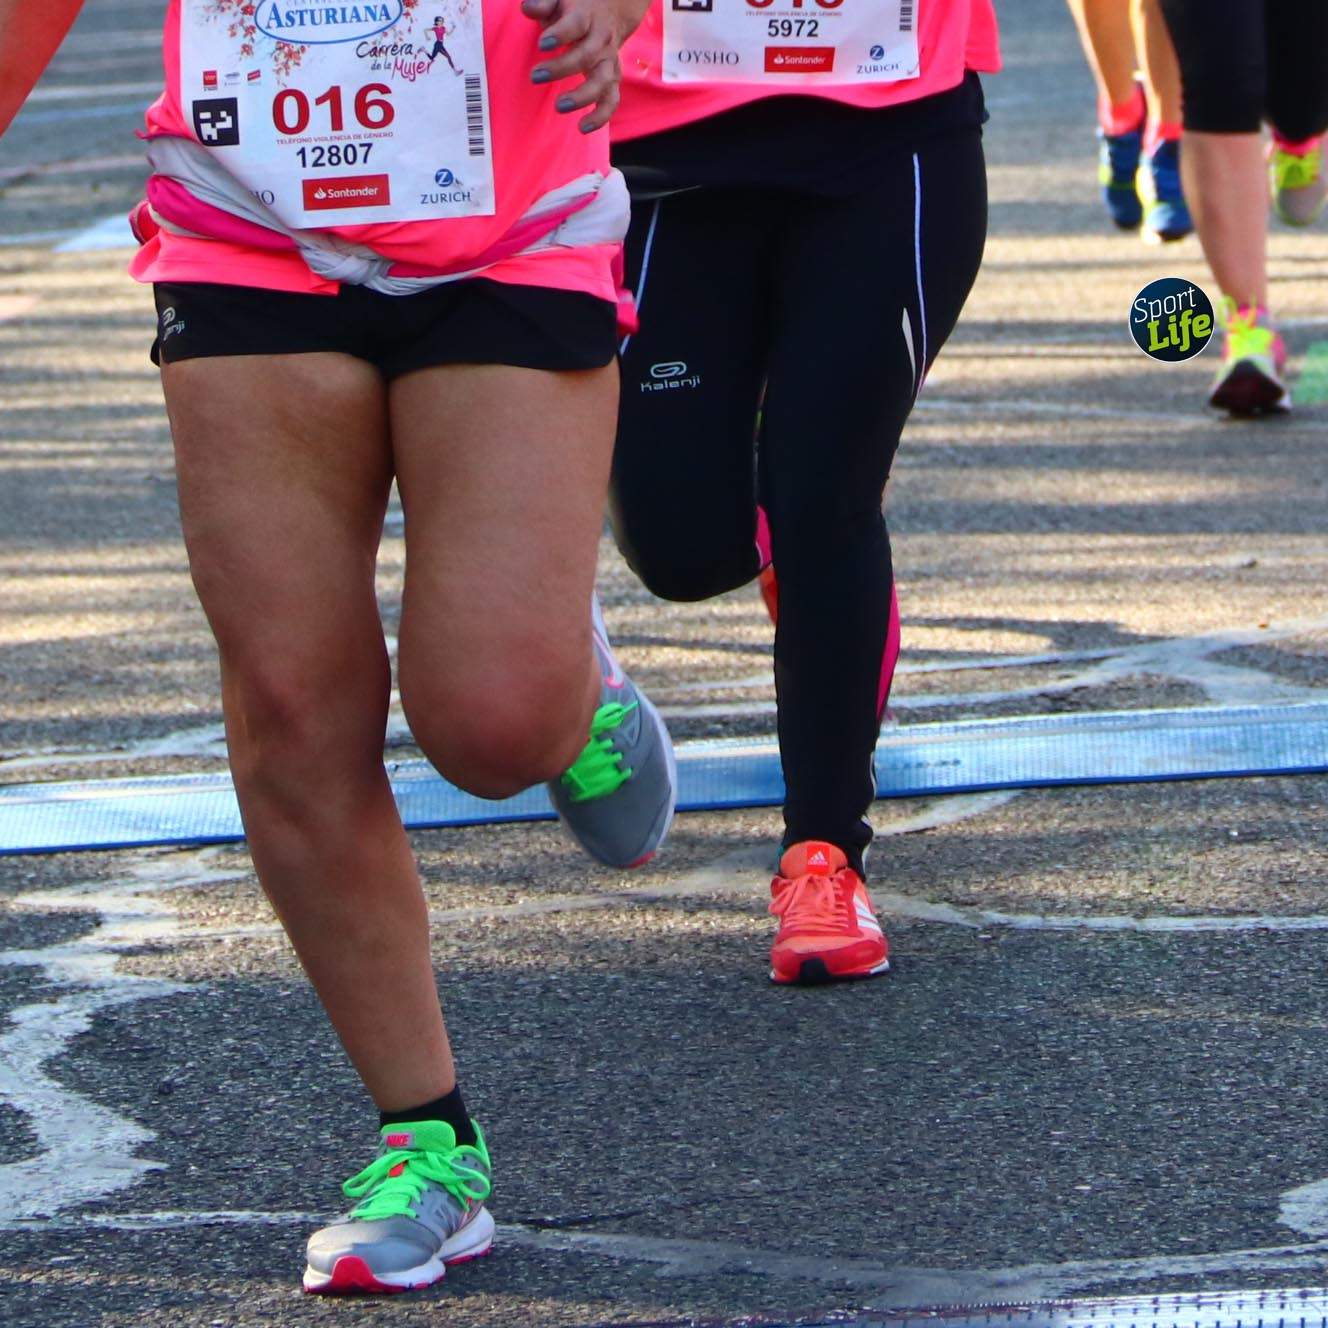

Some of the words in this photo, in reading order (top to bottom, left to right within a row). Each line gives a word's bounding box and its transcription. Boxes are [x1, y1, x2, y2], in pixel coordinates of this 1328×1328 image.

[265, 2, 392, 30] ASTURIANA
[768, 19, 818, 38] 5972
[356, 41, 413, 59] Carrera
[678, 49, 739, 66] OYSHO
[785, 55, 825, 64] Santander
[857, 63, 899, 74] ZURICH
[392, 57, 433, 82] Mujer
[272, 83, 395, 135] 016
[296, 143, 373, 168] 12807
[327, 186, 378, 199] Santander
[420, 191, 471, 205] ZURICH
[640, 375, 701, 393] Kalenji
